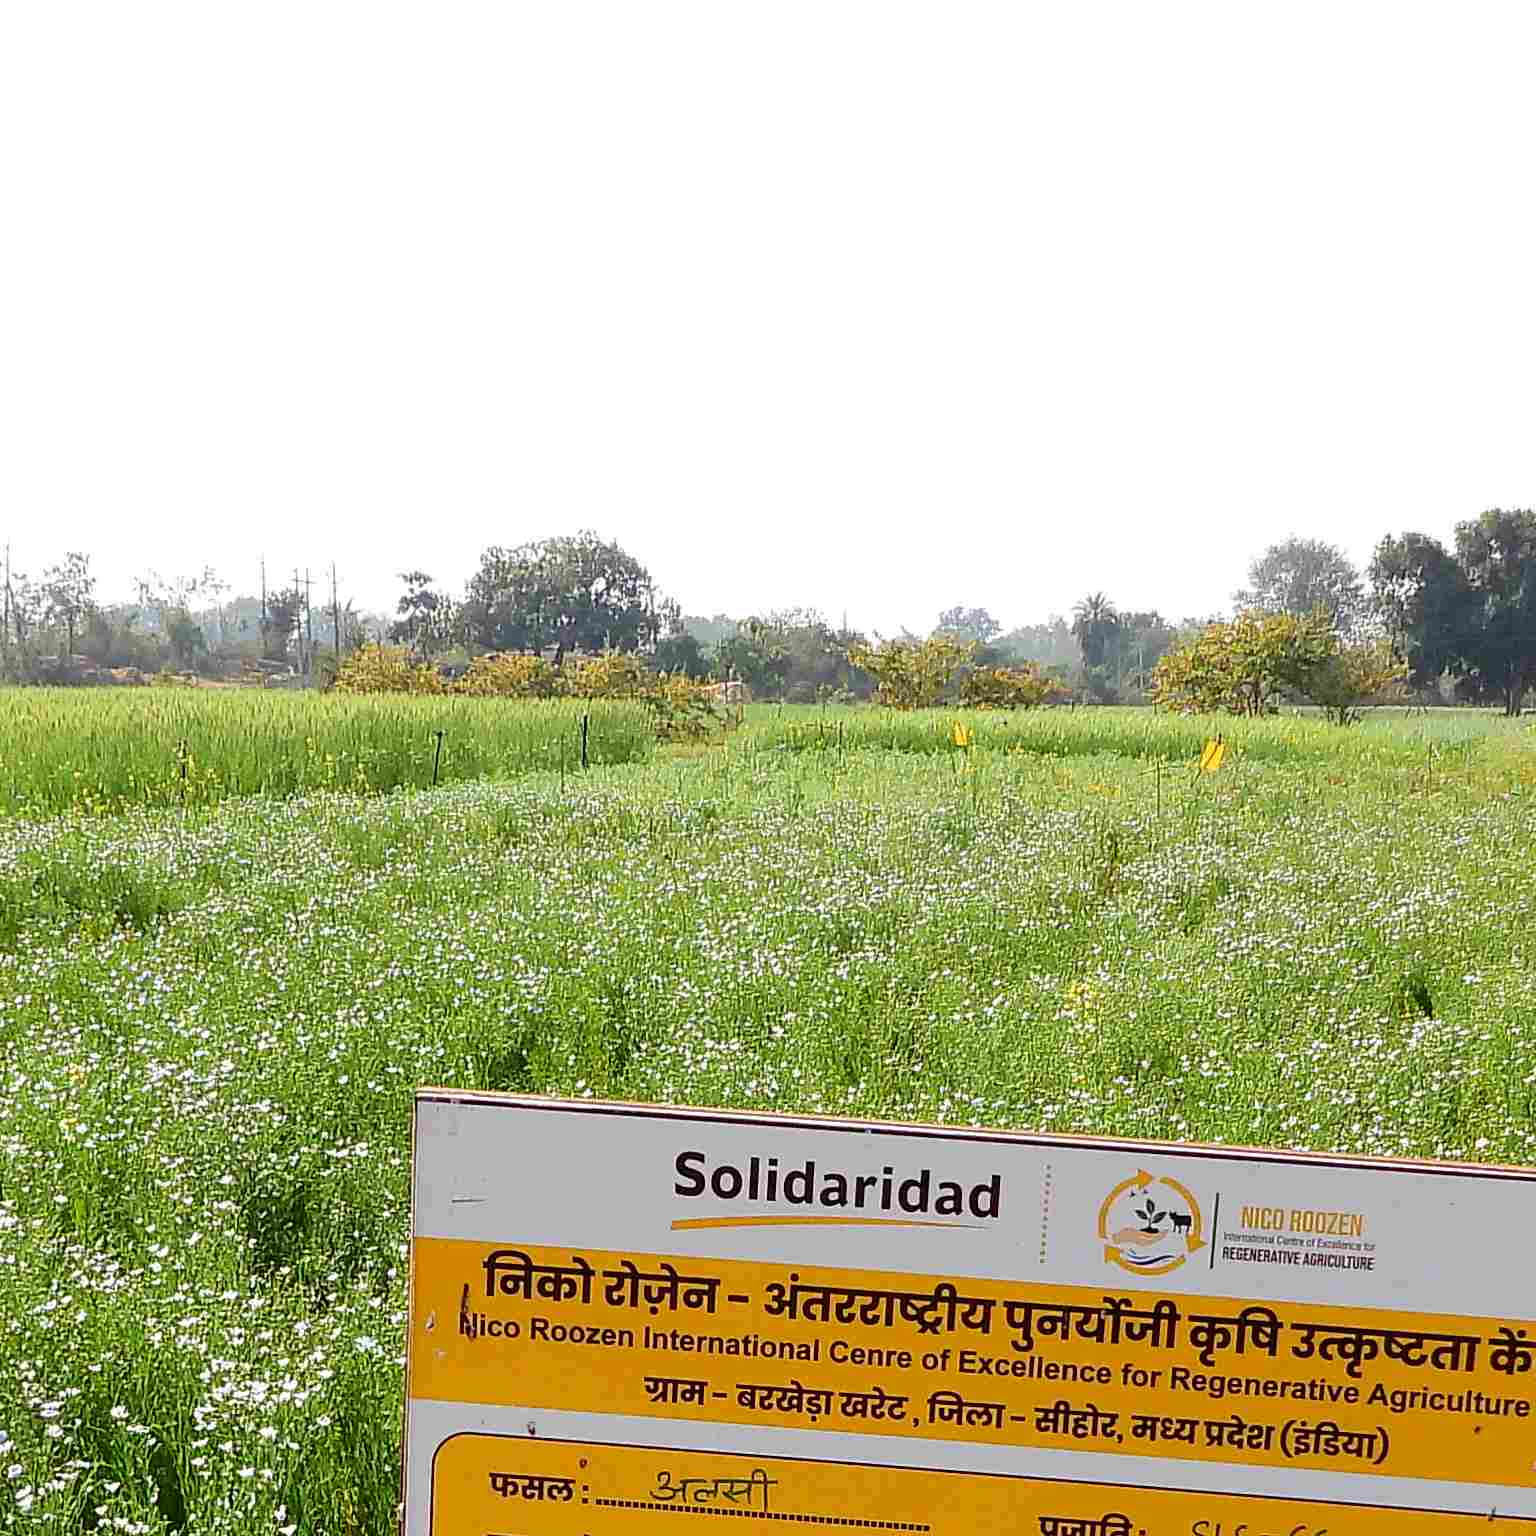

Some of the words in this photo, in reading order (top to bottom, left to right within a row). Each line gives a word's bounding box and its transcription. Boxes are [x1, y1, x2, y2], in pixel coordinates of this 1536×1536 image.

[674, 1151, 1001, 1219] Solidaridad
[1241, 1206, 1285, 1231] NICO
[1289, 1209, 1364, 1237] ROOZEN
[1221, 1245, 1302, 1265] REGENERATIVE
[1302, 1252, 1375, 1271] AGRICULTURE
[482, 1250, 596, 1304] निको
[602, 1260, 721, 1315] रोज़ेन
[764, 1273, 997, 1335] अंतरराष्ट्रीय
[1002, 1296, 1182, 1353] पुनर्योजी
[1188, 1306, 1284, 1367] कृषि
[1290, 1322, 1482, 1379] उत्कृष्टता
[459, 1308, 520, 1339] Nico
[530, 1317, 634, 1347] Roozen
[644, 1326, 819, 1362] International
[829, 1340, 913, 1369] Cenre
[922, 1348, 951, 1371] of
[958, 1350, 1112, 1384] Excellence
[1121, 1363, 1163, 1388] for
[1170, 1367, 1360, 1404] Regenerative
[1367, 1383, 1531, 1417] Agriculture
[643, 1376, 708, 1406] ग्राम
[735, 1380, 834, 1422] बरखेड़ा
[926, 1390, 1006, 1429] जिला
[1034, 1400, 1123, 1444] सीहोर,
[1131, 1415, 1200, 1444] मध्य
[1203, 1414, 1276, 1451] प्रदेश
[1280, 1419, 1389, 1465] (इंडिया)
